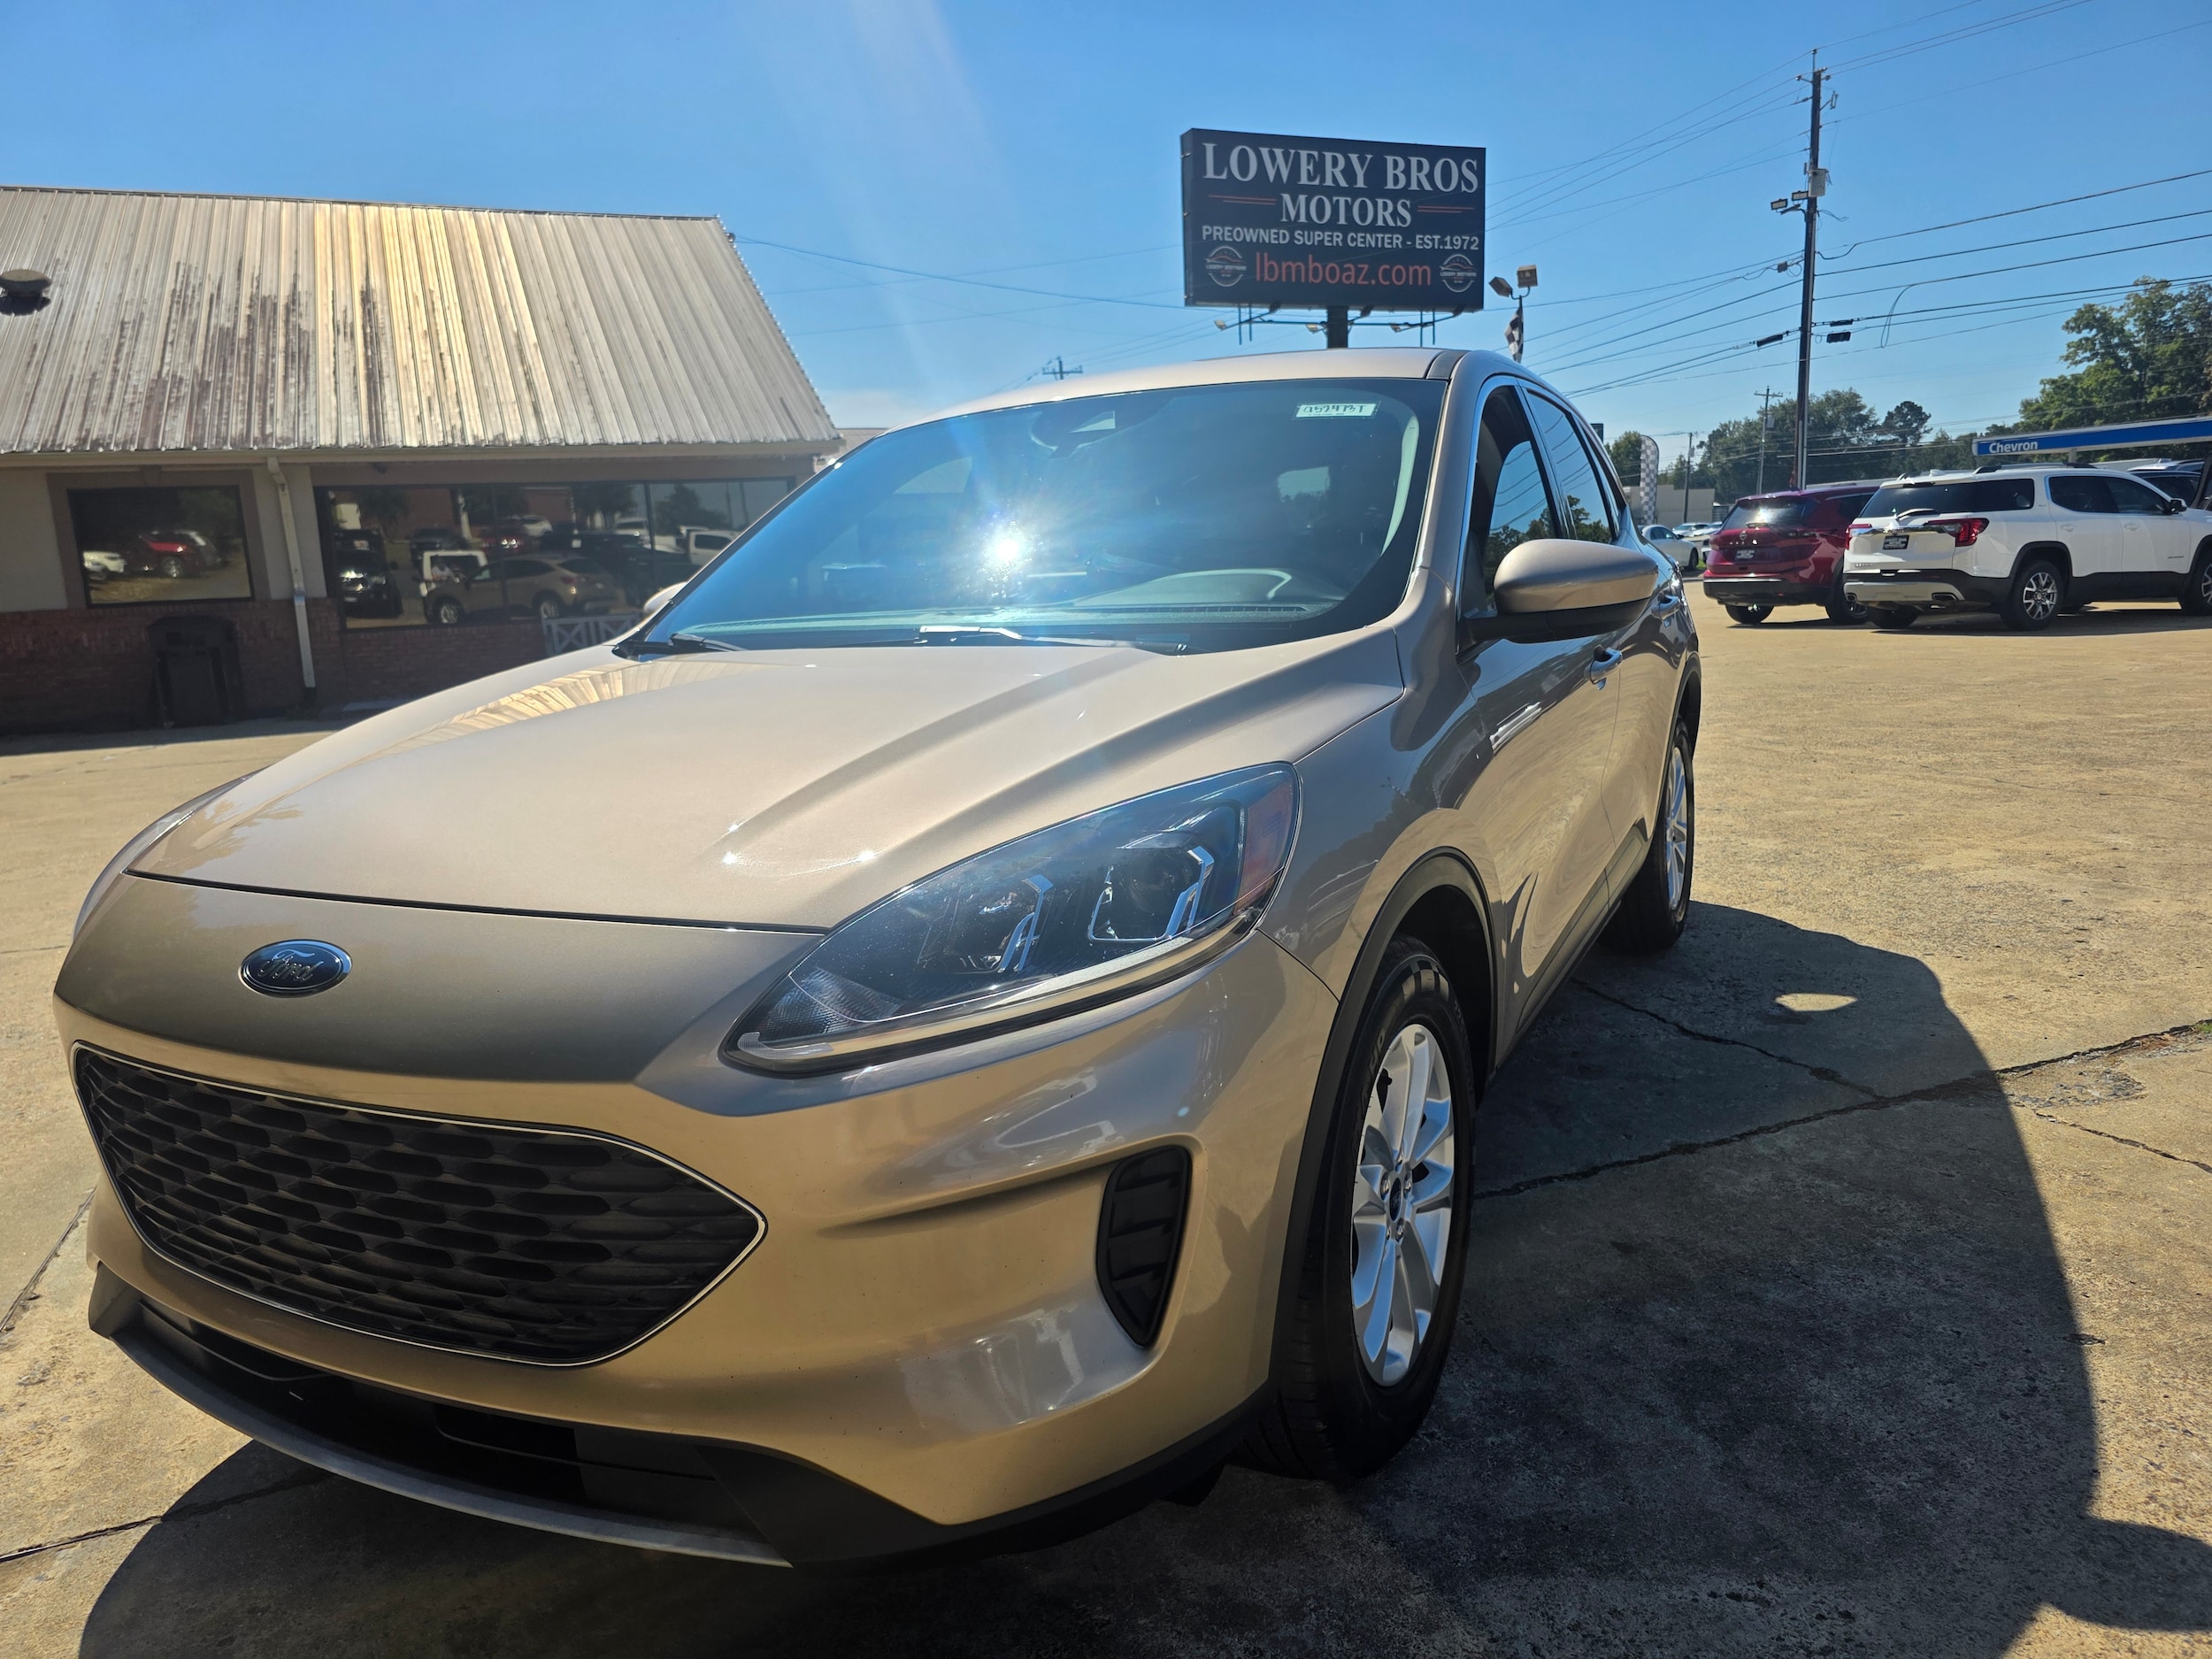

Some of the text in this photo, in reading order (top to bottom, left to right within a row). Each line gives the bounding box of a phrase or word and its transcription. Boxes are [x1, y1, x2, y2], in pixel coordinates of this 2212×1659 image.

[1202, 142, 1479, 194] LOWERY BROS
[1280, 193, 1411, 227] MOTORS
[1202, 225, 1290, 244] PREOWNED
[1294, 230, 1343, 247] SUPER
[1347, 232, 1402, 249] CENTER
[1415, 234, 1479, 250] EST.1972
[1256, 251, 1432, 286] lbmboaz.com
[1988, 441, 2039, 454] Chevron
